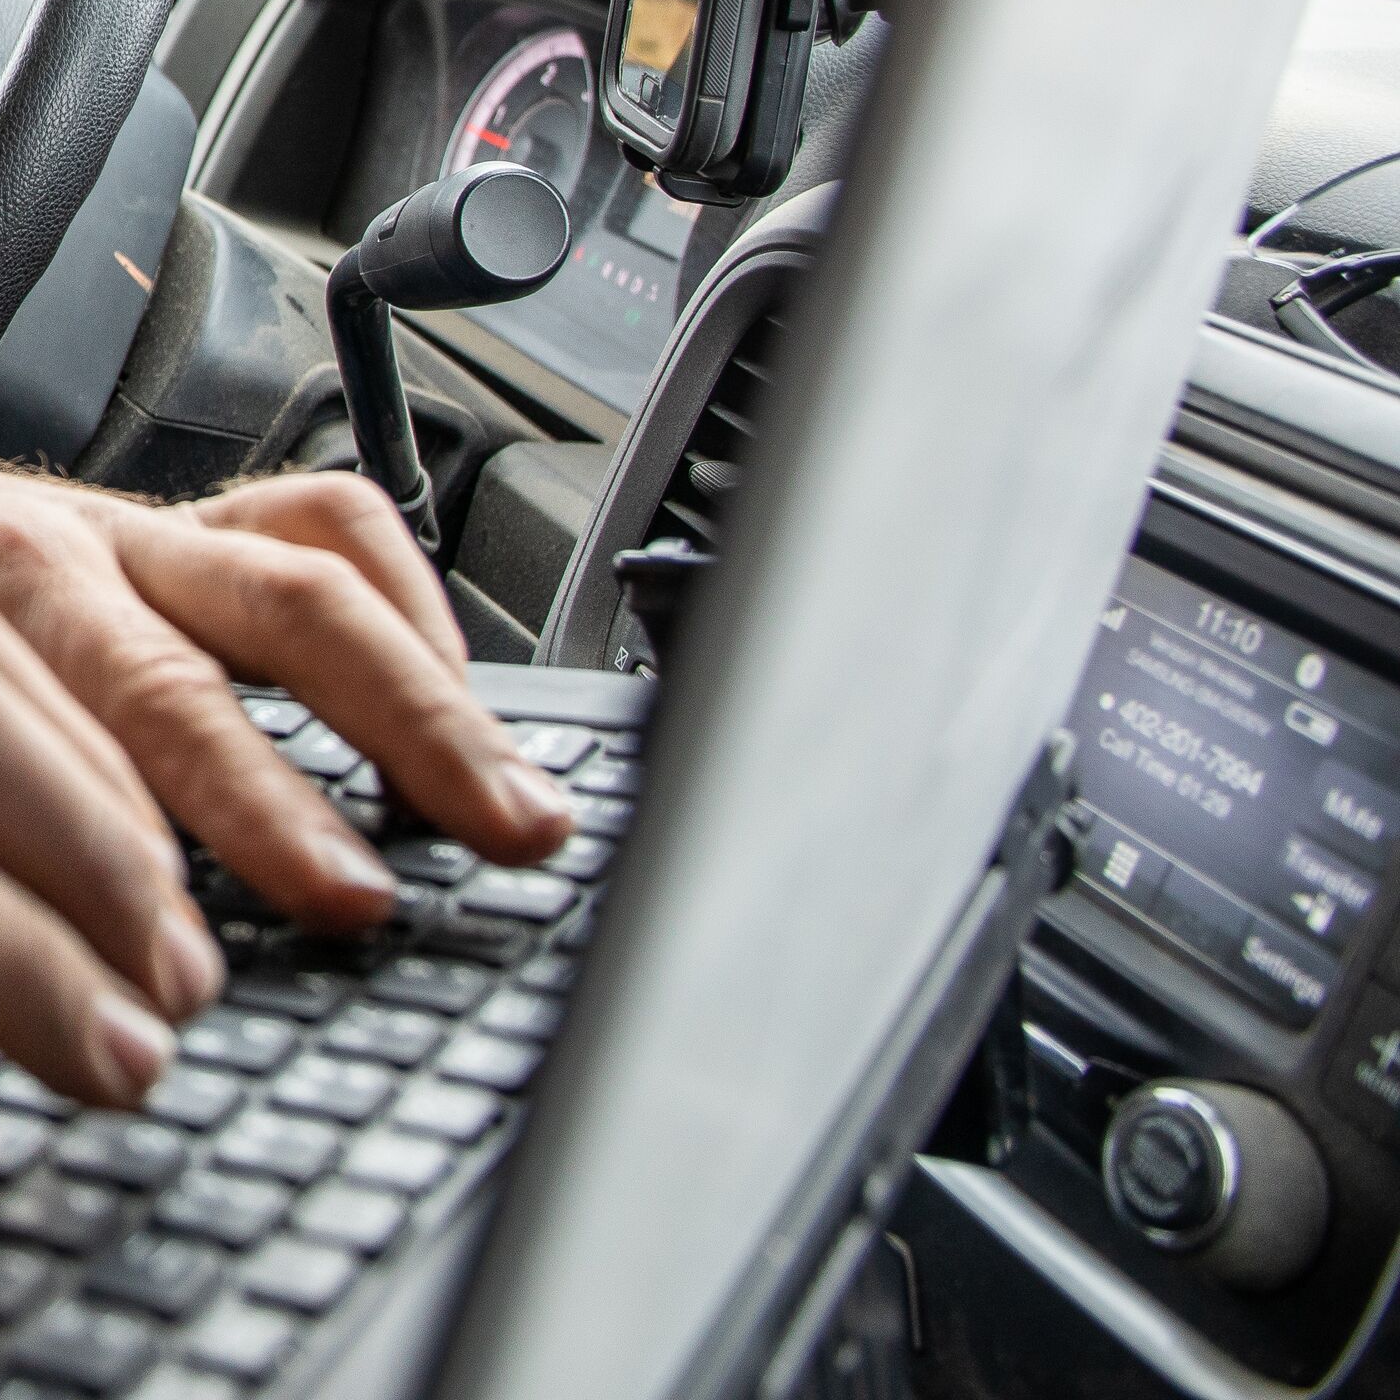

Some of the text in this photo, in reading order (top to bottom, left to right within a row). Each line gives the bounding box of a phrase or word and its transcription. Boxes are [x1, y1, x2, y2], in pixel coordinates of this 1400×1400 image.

[1196, 602, 1261, 653] 11:10
[1100, 728, 1139, 759] Call
[1137, 747, 1176, 785] Time
[1324, 789, 1380, 836] Mute
[1242, 935, 1325, 1005] Settings
